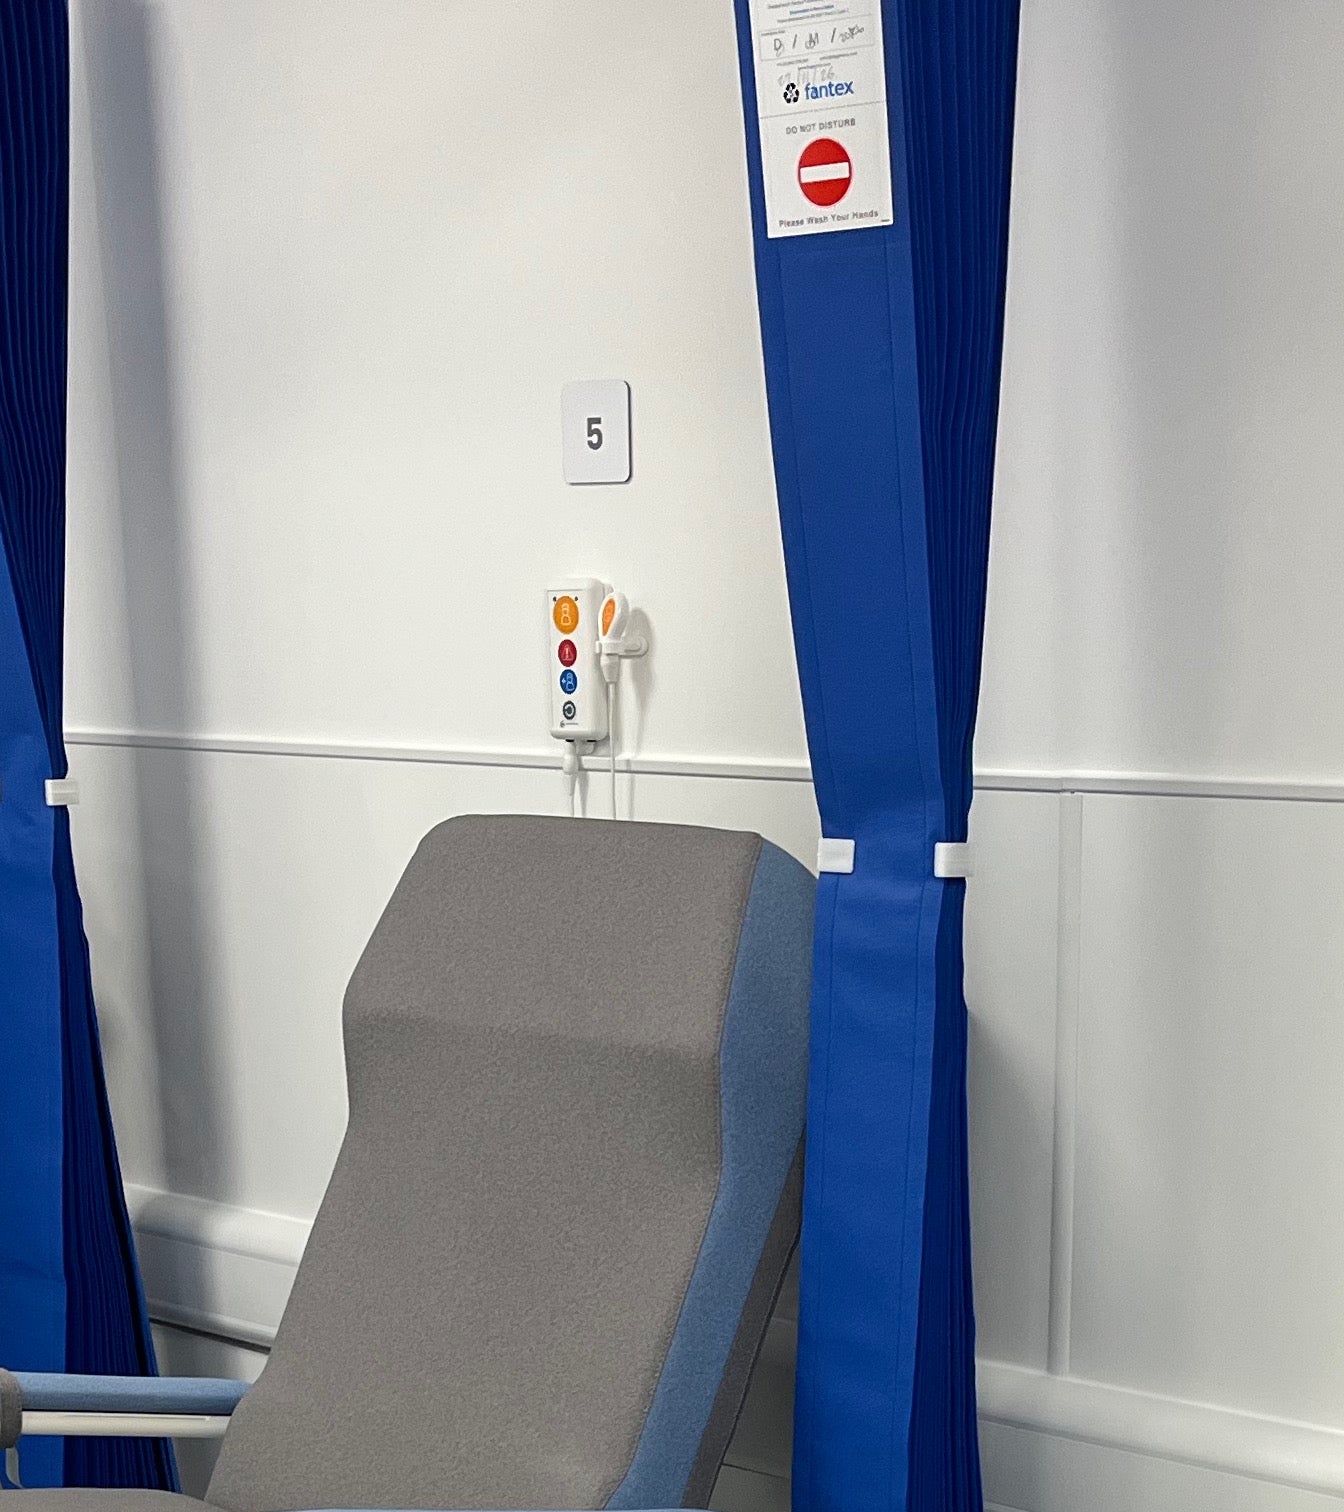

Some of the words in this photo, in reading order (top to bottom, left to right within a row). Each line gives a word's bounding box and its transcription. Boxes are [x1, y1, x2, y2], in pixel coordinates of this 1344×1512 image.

[804, 80, 855, 100] fantex
[785, 126, 798, 135] DO
[800, 123, 817, 133] NOT
[819, 118, 856, 131] DISTURB
[779, 217, 805, 228] Please
[807, 214, 829, 225] Wash
[831, 212, 850, 222] Your
[852, 209, 879, 220] Hands
[587, 417, 603, 451] 5
